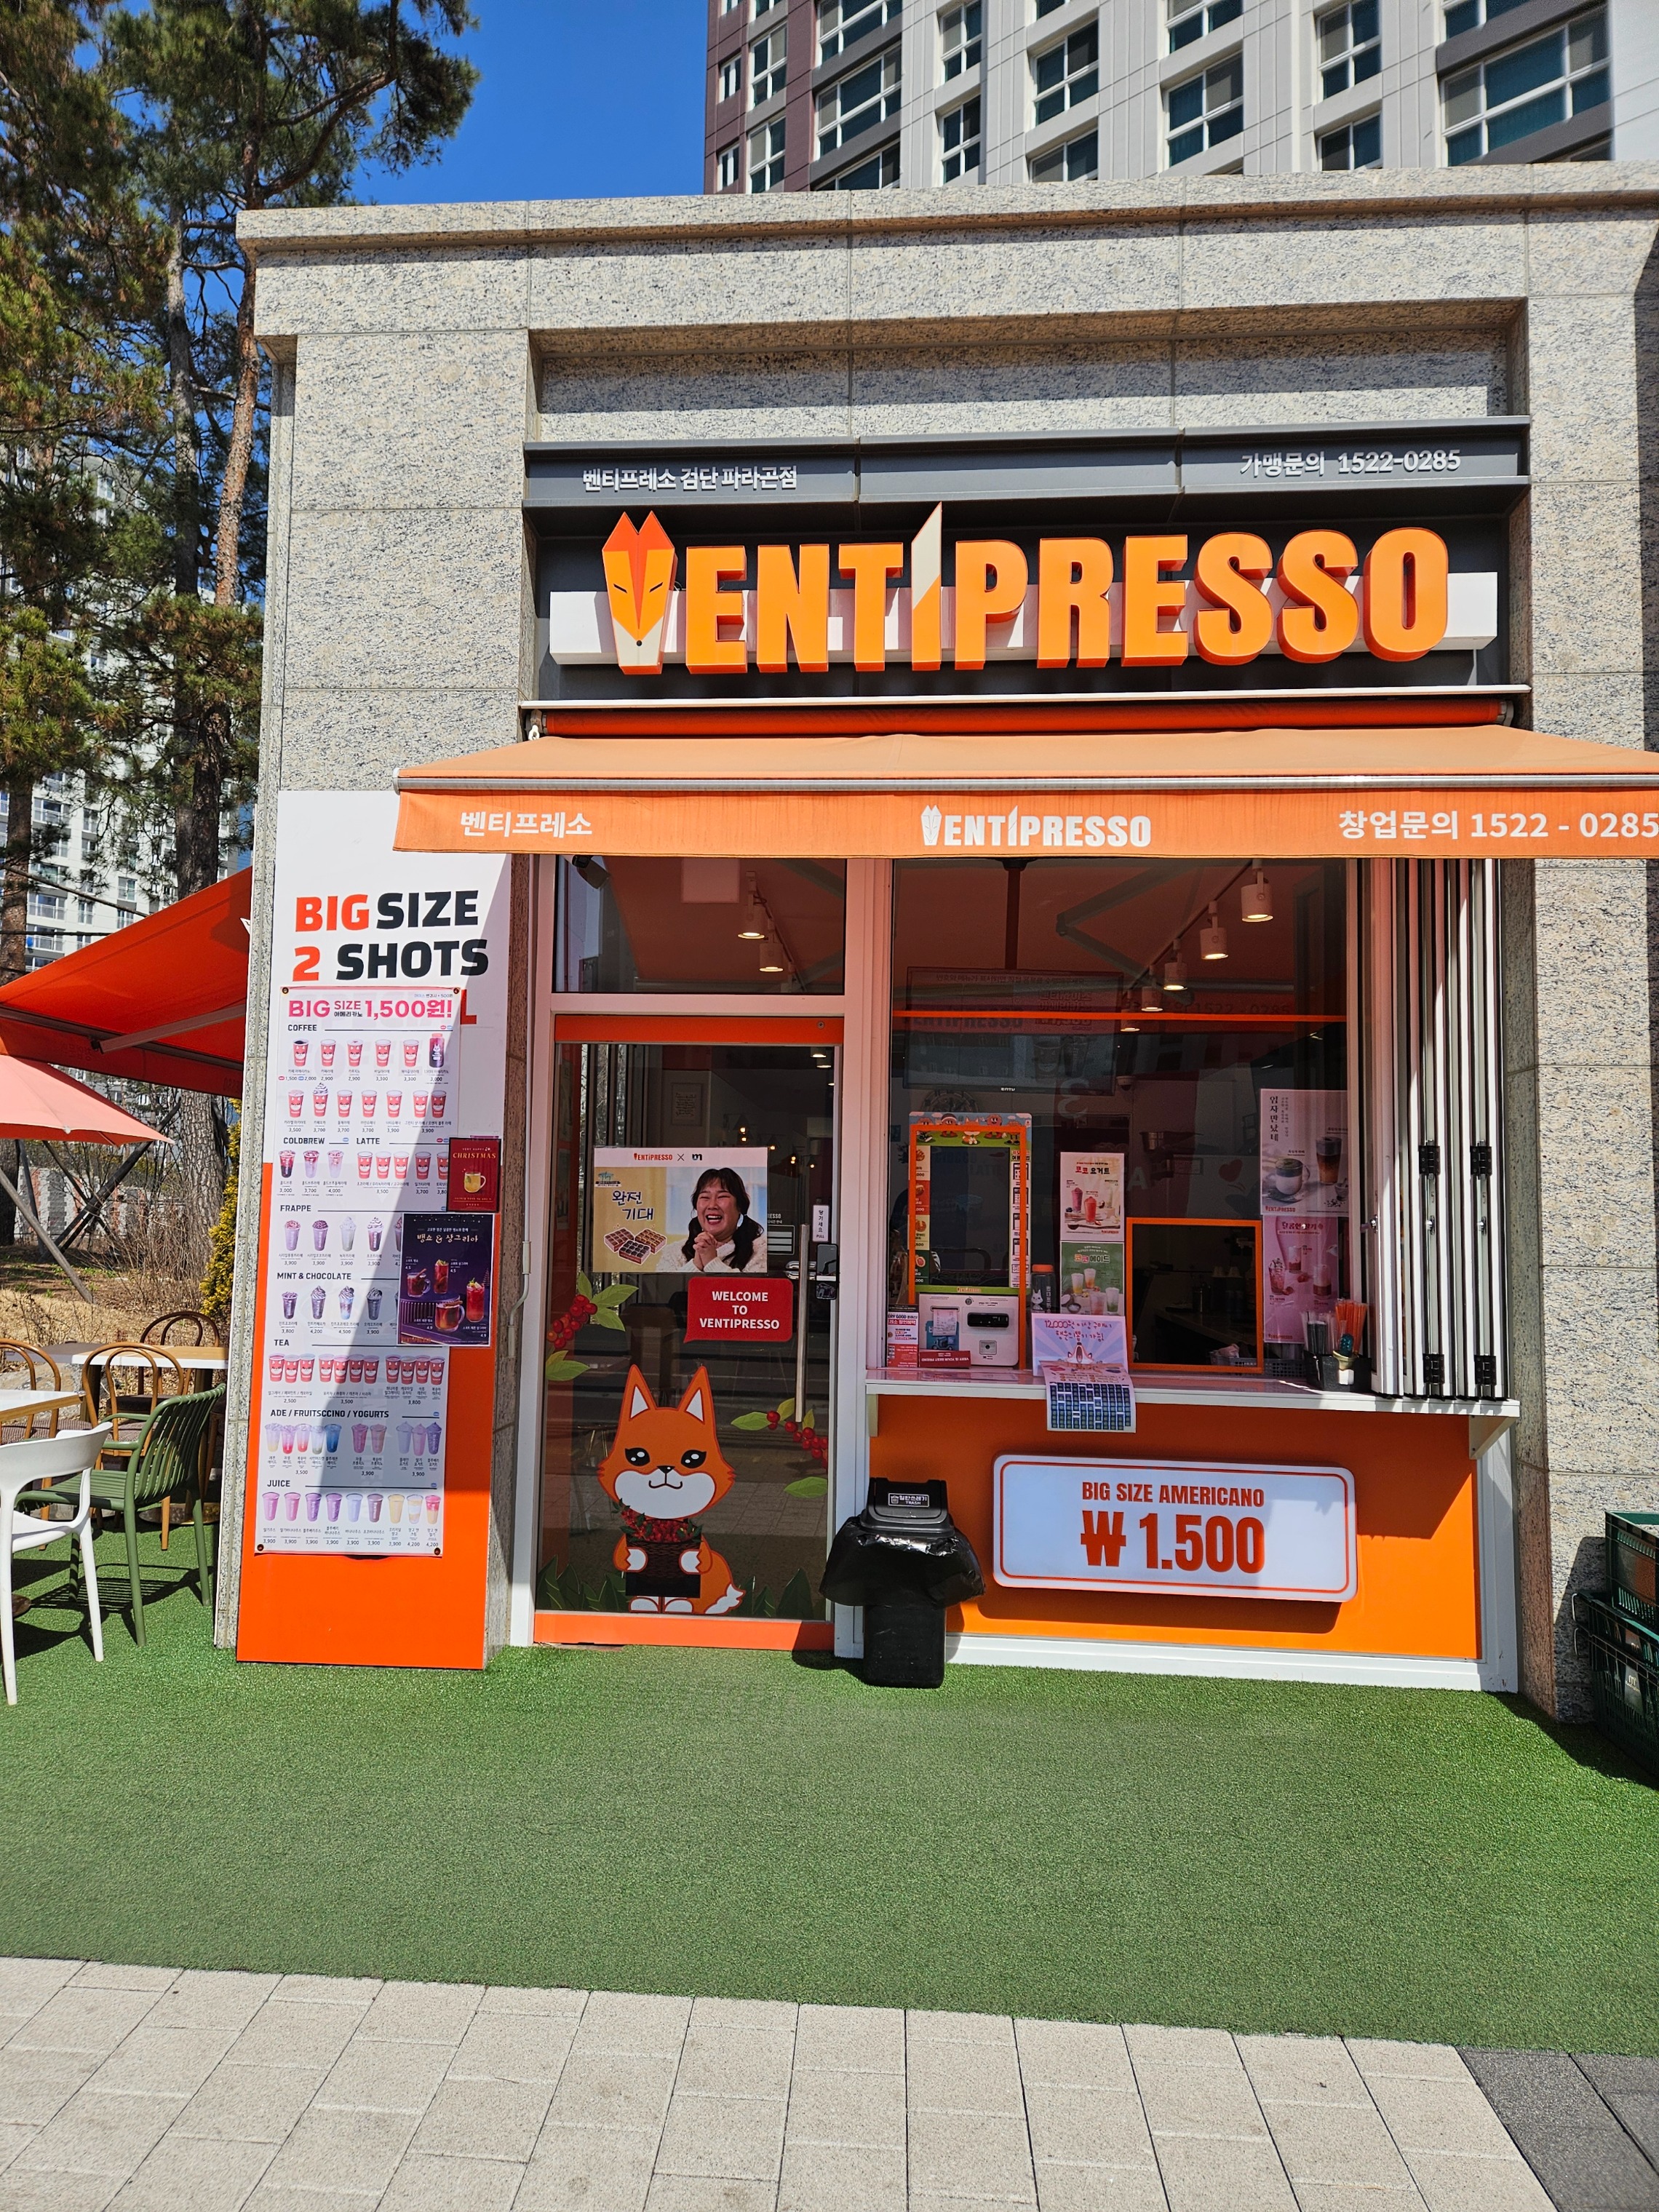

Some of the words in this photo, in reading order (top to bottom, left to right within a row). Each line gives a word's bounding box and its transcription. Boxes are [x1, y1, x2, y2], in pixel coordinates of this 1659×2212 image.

[1241, 452, 1325, 476] 가맹문의
[1338, 450, 1461, 474] 1522-0285
[582, 468, 676, 493] 벤티프레소
[680, 468, 717, 491] 검단
[721, 466, 797, 490] 파라곤점
[602, 502, 1449, 675] VENTIPRESSO
[460, 811, 592, 838] 벤티프레소
[920, 804, 1152, 848] VENTIPRESSO
[1339, 810, 1458, 840] 창업문의
[1471, 812, 1548, 838] 1522
[1579, 812, 1659, 838] 0285
[295, 894, 370, 933] BIG
[376, 890, 479, 931] SIZE
[292, 945, 320, 982] 2
[335, 939, 490, 982] SHOTS
[288, 1000, 330, 1018] BIG
[334, 1000, 362, 1010] SIZE
[365, 999, 453, 1021] 1,500원!
[287, 1024, 317, 1032] COFFEE
[1270, 1096, 1278, 1142] 임자만났네
[634, 1153, 673, 1161] VENTIPRESSO
[1075, 1166, 1089, 1174] 코코
[612, 1190, 642, 1206] 완전
[621, 1208, 654, 1220] 기대
[417, 1233, 433, 1243] 뱅쇼
[435, 1234, 442, 1244] &
[445, 1233, 478, 1243] 상그리아
[1089, 1254, 1110, 1262] 에이드
[712, 1291, 768, 1302] WELCOME
[732, 1305, 748, 1316] TO
[699, 1318, 780, 1329] VENTIPRESSO
[1077, 1321, 1091, 1329] 이상
[1094, 1321, 1112, 1329] 구매시
[294, 1409, 346, 1418] FRUITSCCINO
[353, 1410, 389, 1418] YOGURTS
[1082, 1481, 1110, 1502] BIG
[1115, 1483, 1153, 1503] SIZE
[1158, 1484, 1265, 1508] AMERICANO
[1139, 1512, 1265, 1575] 1.500
